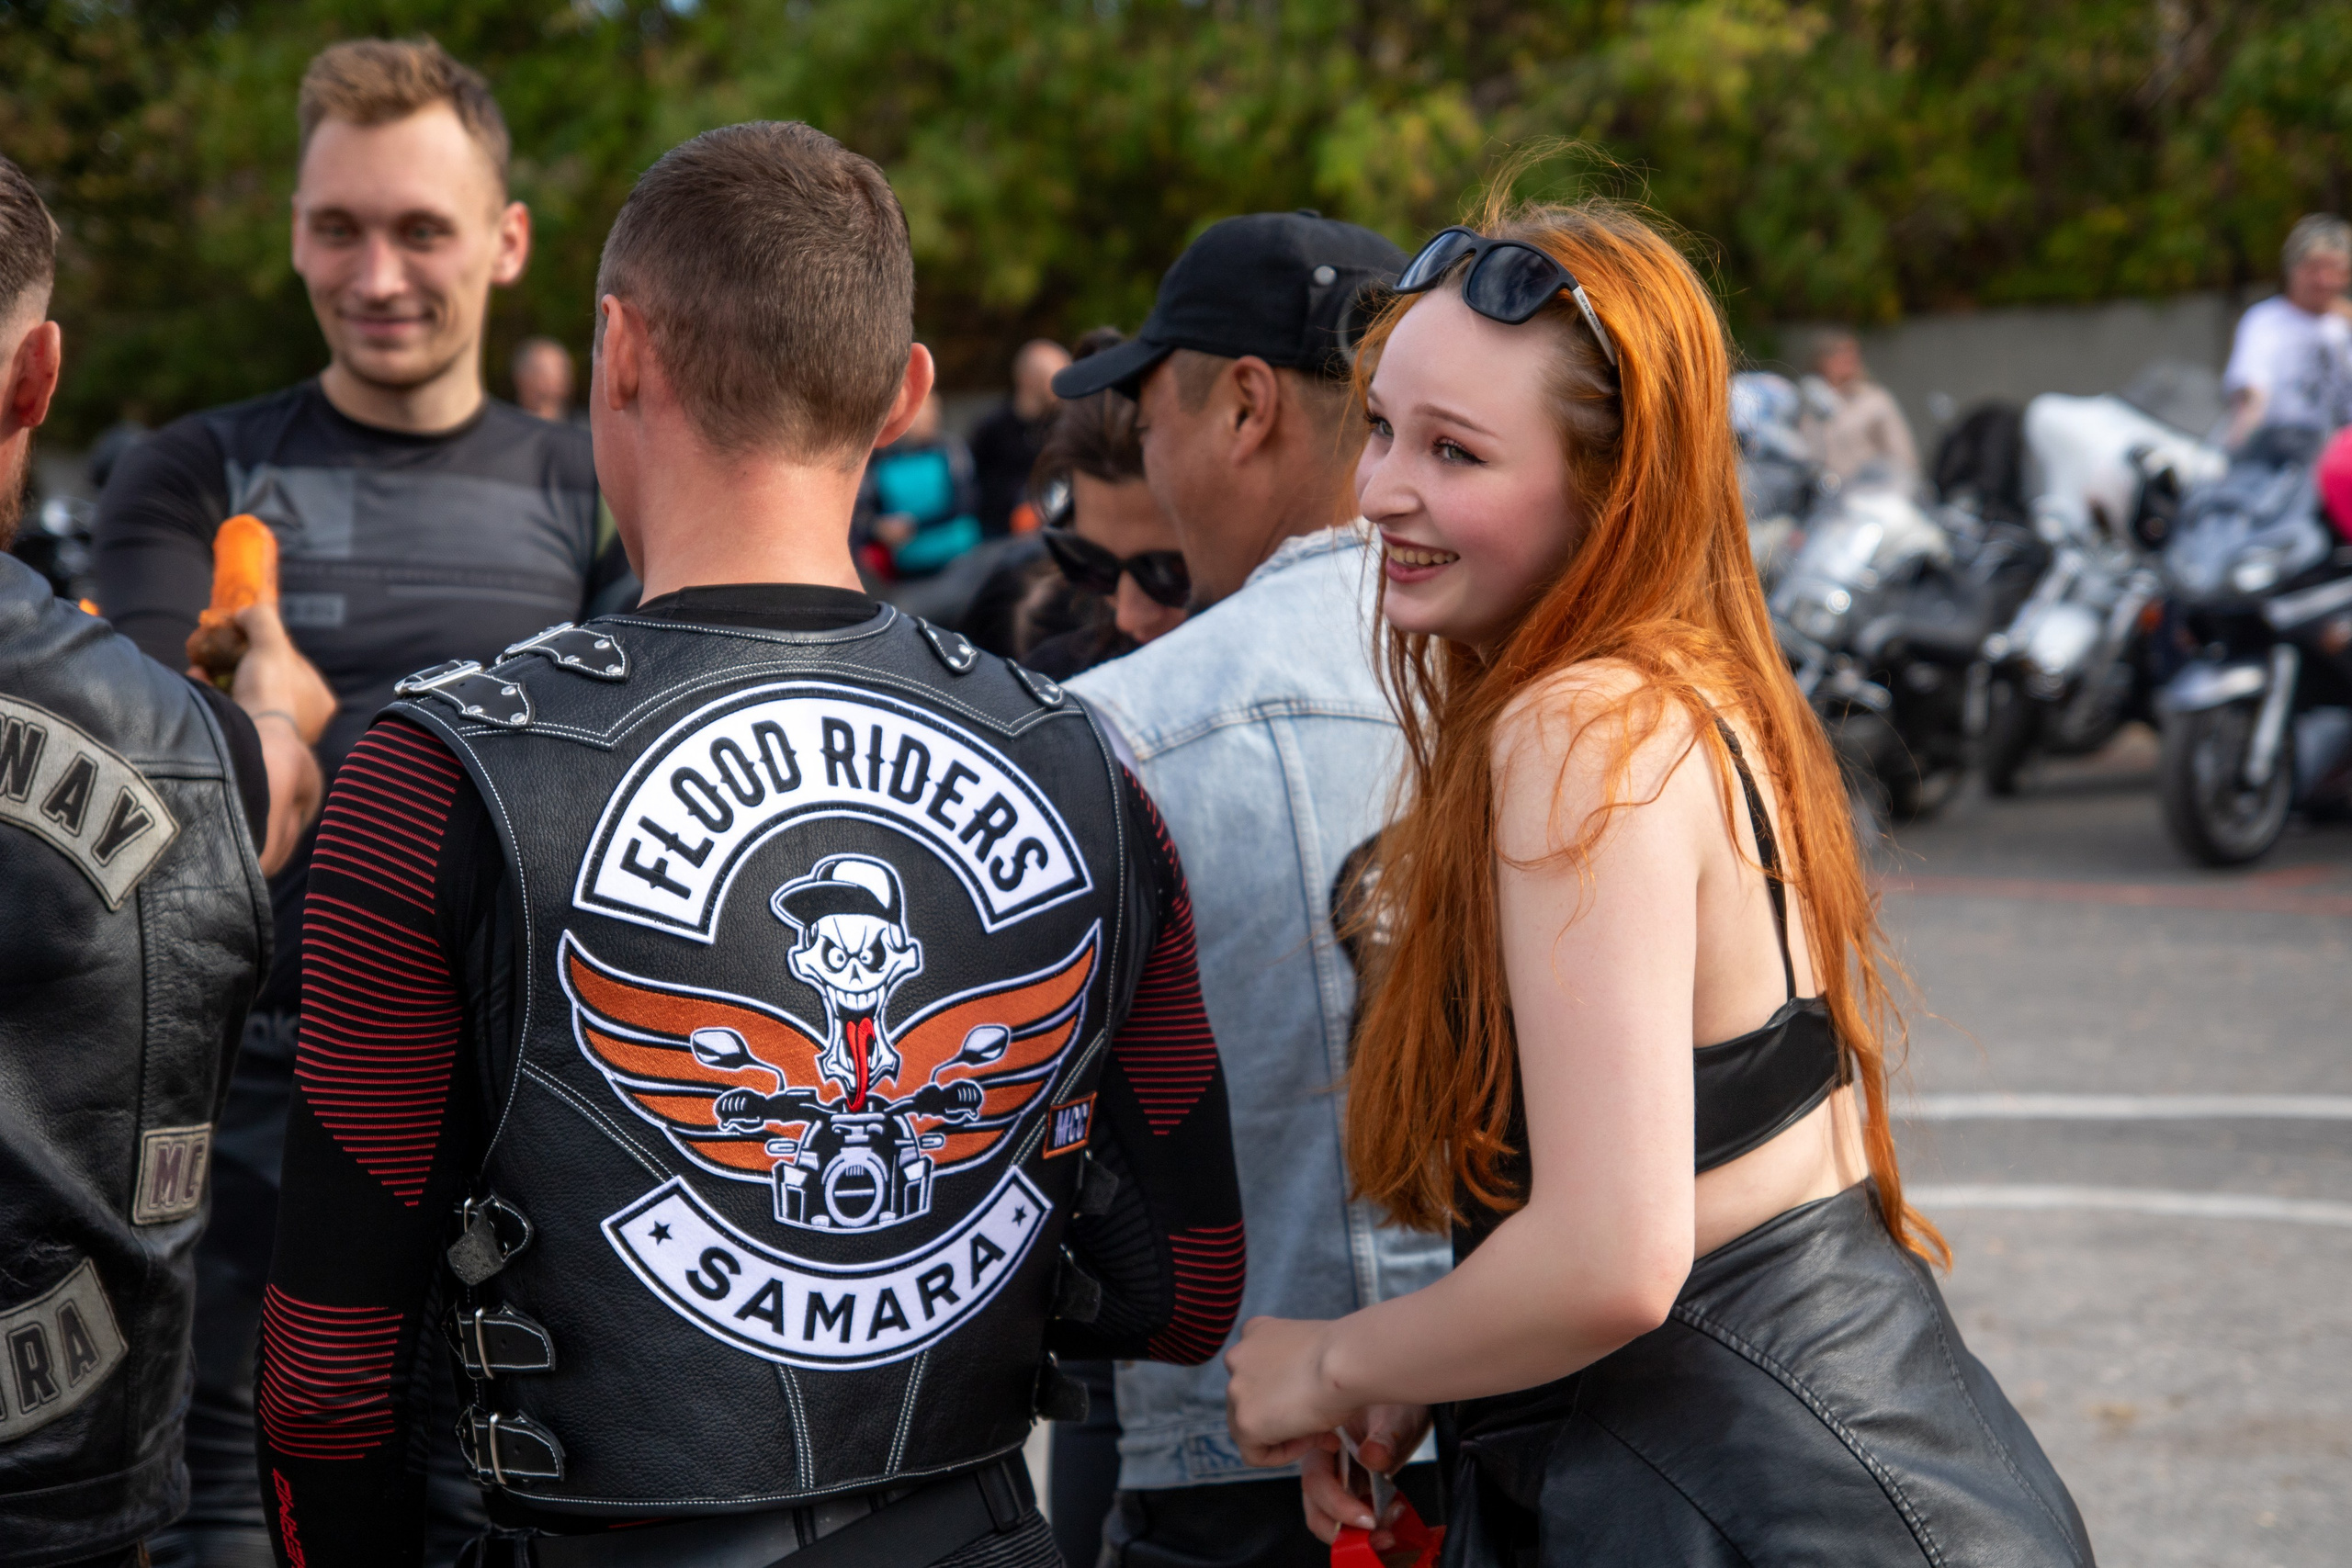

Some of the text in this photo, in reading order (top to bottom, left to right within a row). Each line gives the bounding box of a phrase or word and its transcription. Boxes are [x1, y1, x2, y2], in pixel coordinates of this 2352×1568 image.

[618, 716, 1049, 900] FLOOD RIDERS
[149, 1141, 204, 1207] MC
[684, 1231, 1007, 1344] SAMARA
[0, 1298, 100, 1422] RA
